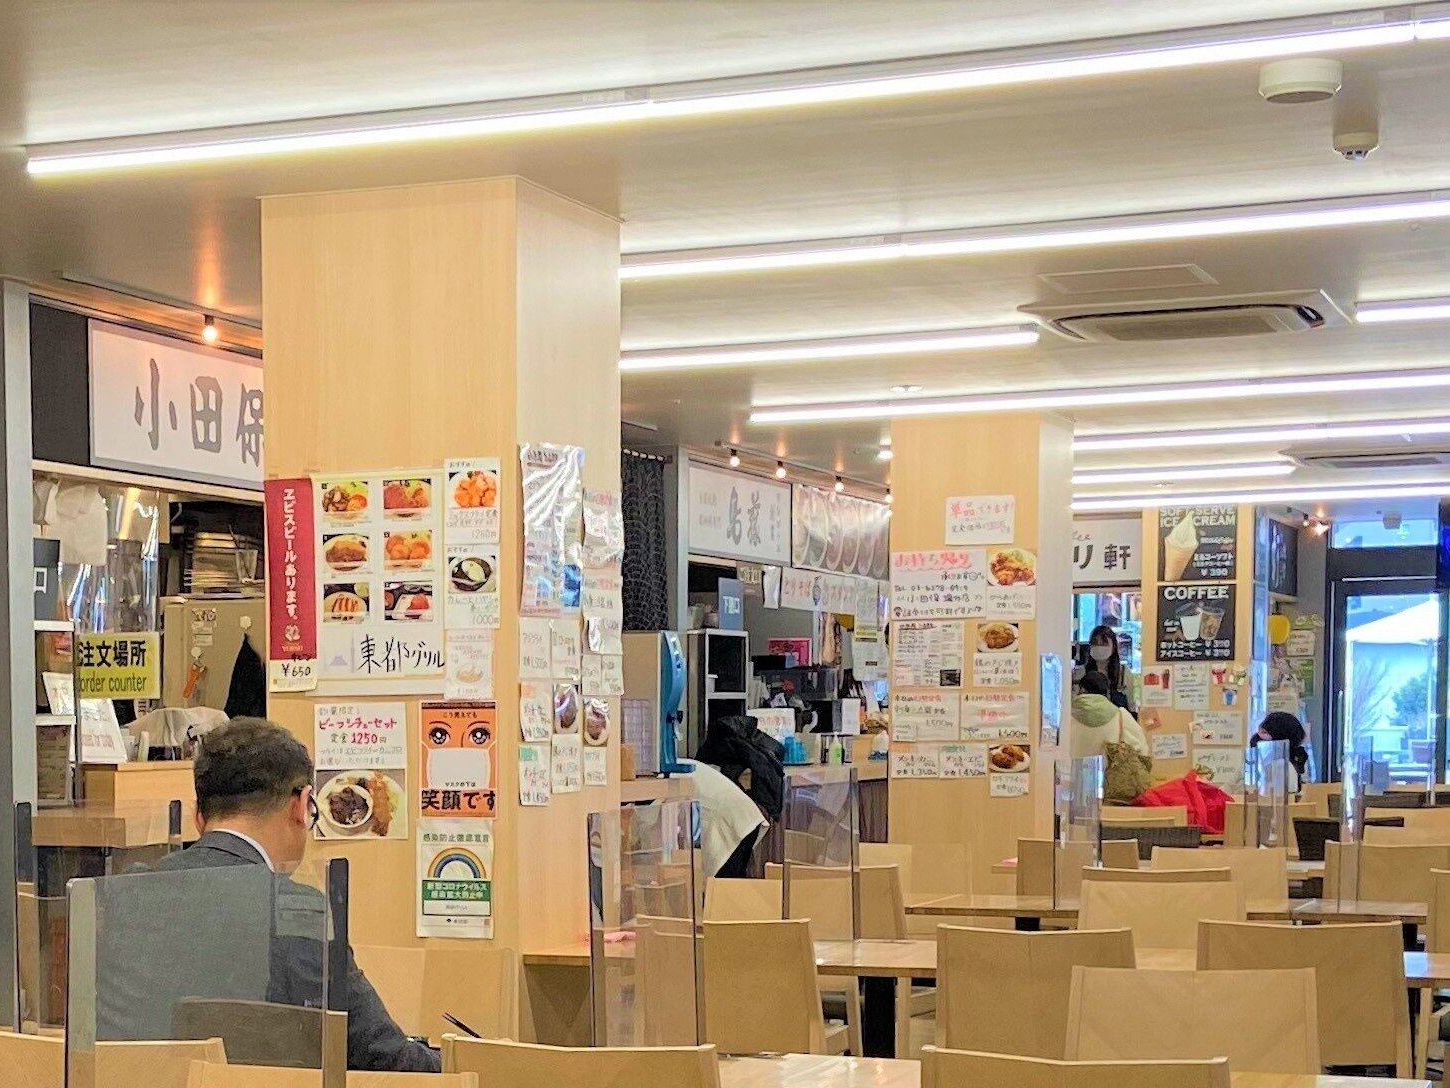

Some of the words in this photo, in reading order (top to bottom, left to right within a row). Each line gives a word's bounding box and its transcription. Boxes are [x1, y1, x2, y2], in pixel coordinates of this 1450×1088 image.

[1160, 516, 1180, 527] ICE
[1193, 515, 1236, 526] CREAM
[1164, 586, 1230, 600] COFFEE
[78, 640, 147, 668] 注文場所
[358, 634, 445, 674] 東都グリル
[80, 675, 106, 693] order
[108, 674, 147, 692] counter
[421, 789, 496, 811] 笑顔です
